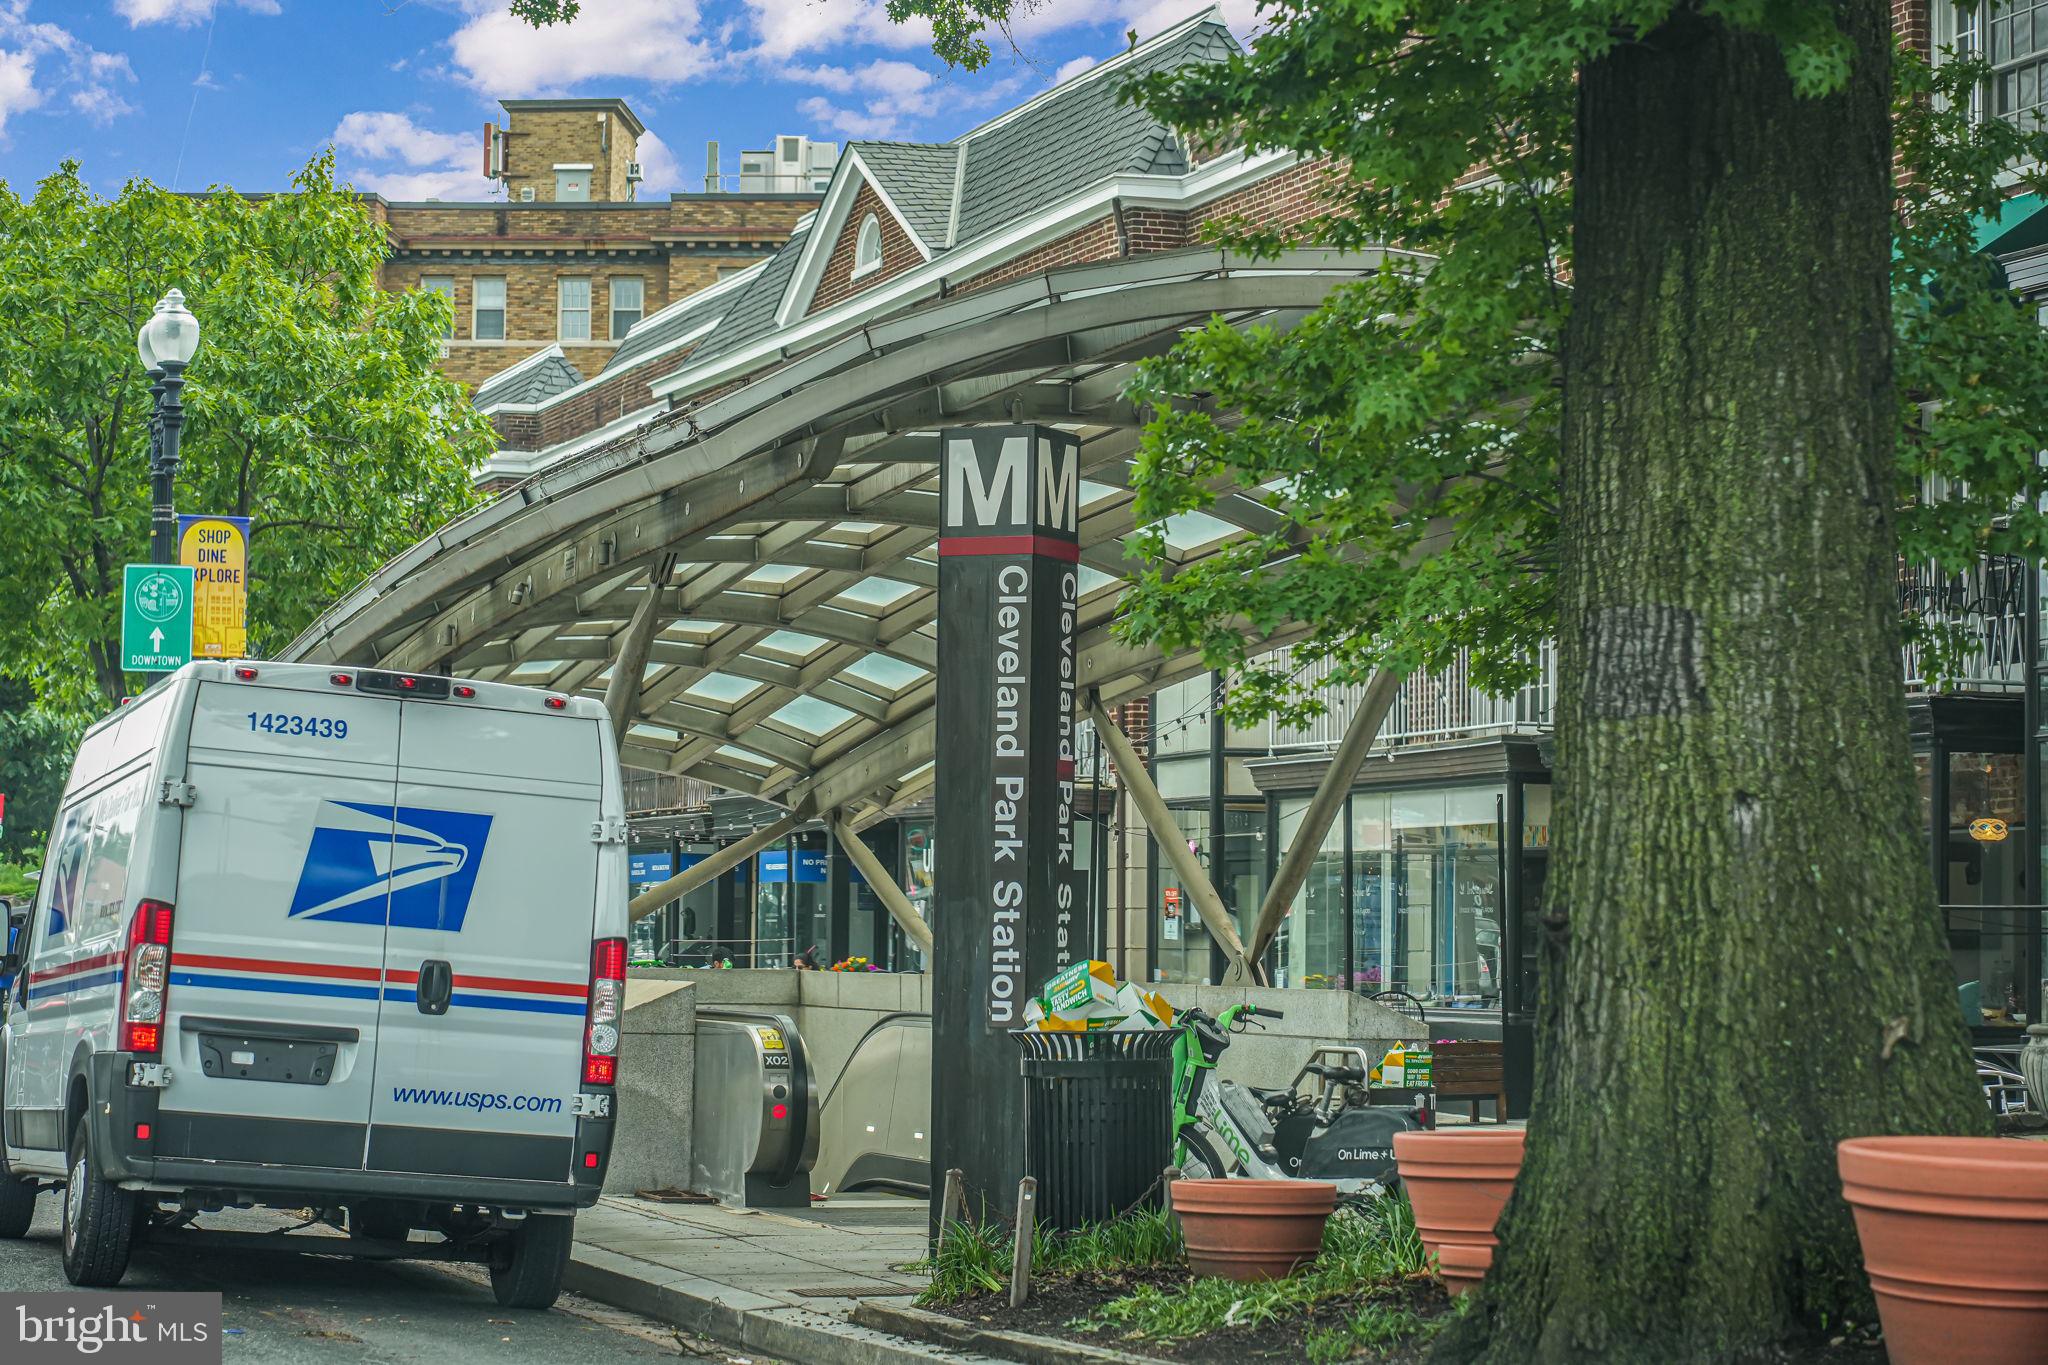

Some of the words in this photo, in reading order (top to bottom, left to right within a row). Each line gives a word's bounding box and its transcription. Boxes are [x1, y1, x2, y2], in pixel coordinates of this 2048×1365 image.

[947, 437, 1029, 527] M
[1036, 437, 1078, 533] M
[198, 529, 232, 544] SHOP
[198, 548, 227, 564] DINE
[194, 568, 241, 584] XPLORE
[131, 654, 182, 666] DOWNTOWN
[995, 565, 1029, 757] Cleveland
[1058, 572, 1077, 761] Cleveland
[247, 711, 348, 739] 1423439
[993, 777, 1025, 863] Park
[1057, 780, 1073, 864] Park
[991, 880, 1023, 1022] Station
[1056, 882, 1073, 973] Stati
[393, 1087, 562, 1113] www.usps.com
[1214, 1109, 1250, 1164] Lime
[1338, 1149, 1352, 1161] On
[1353, 1148, 1379, 1160] Lime
